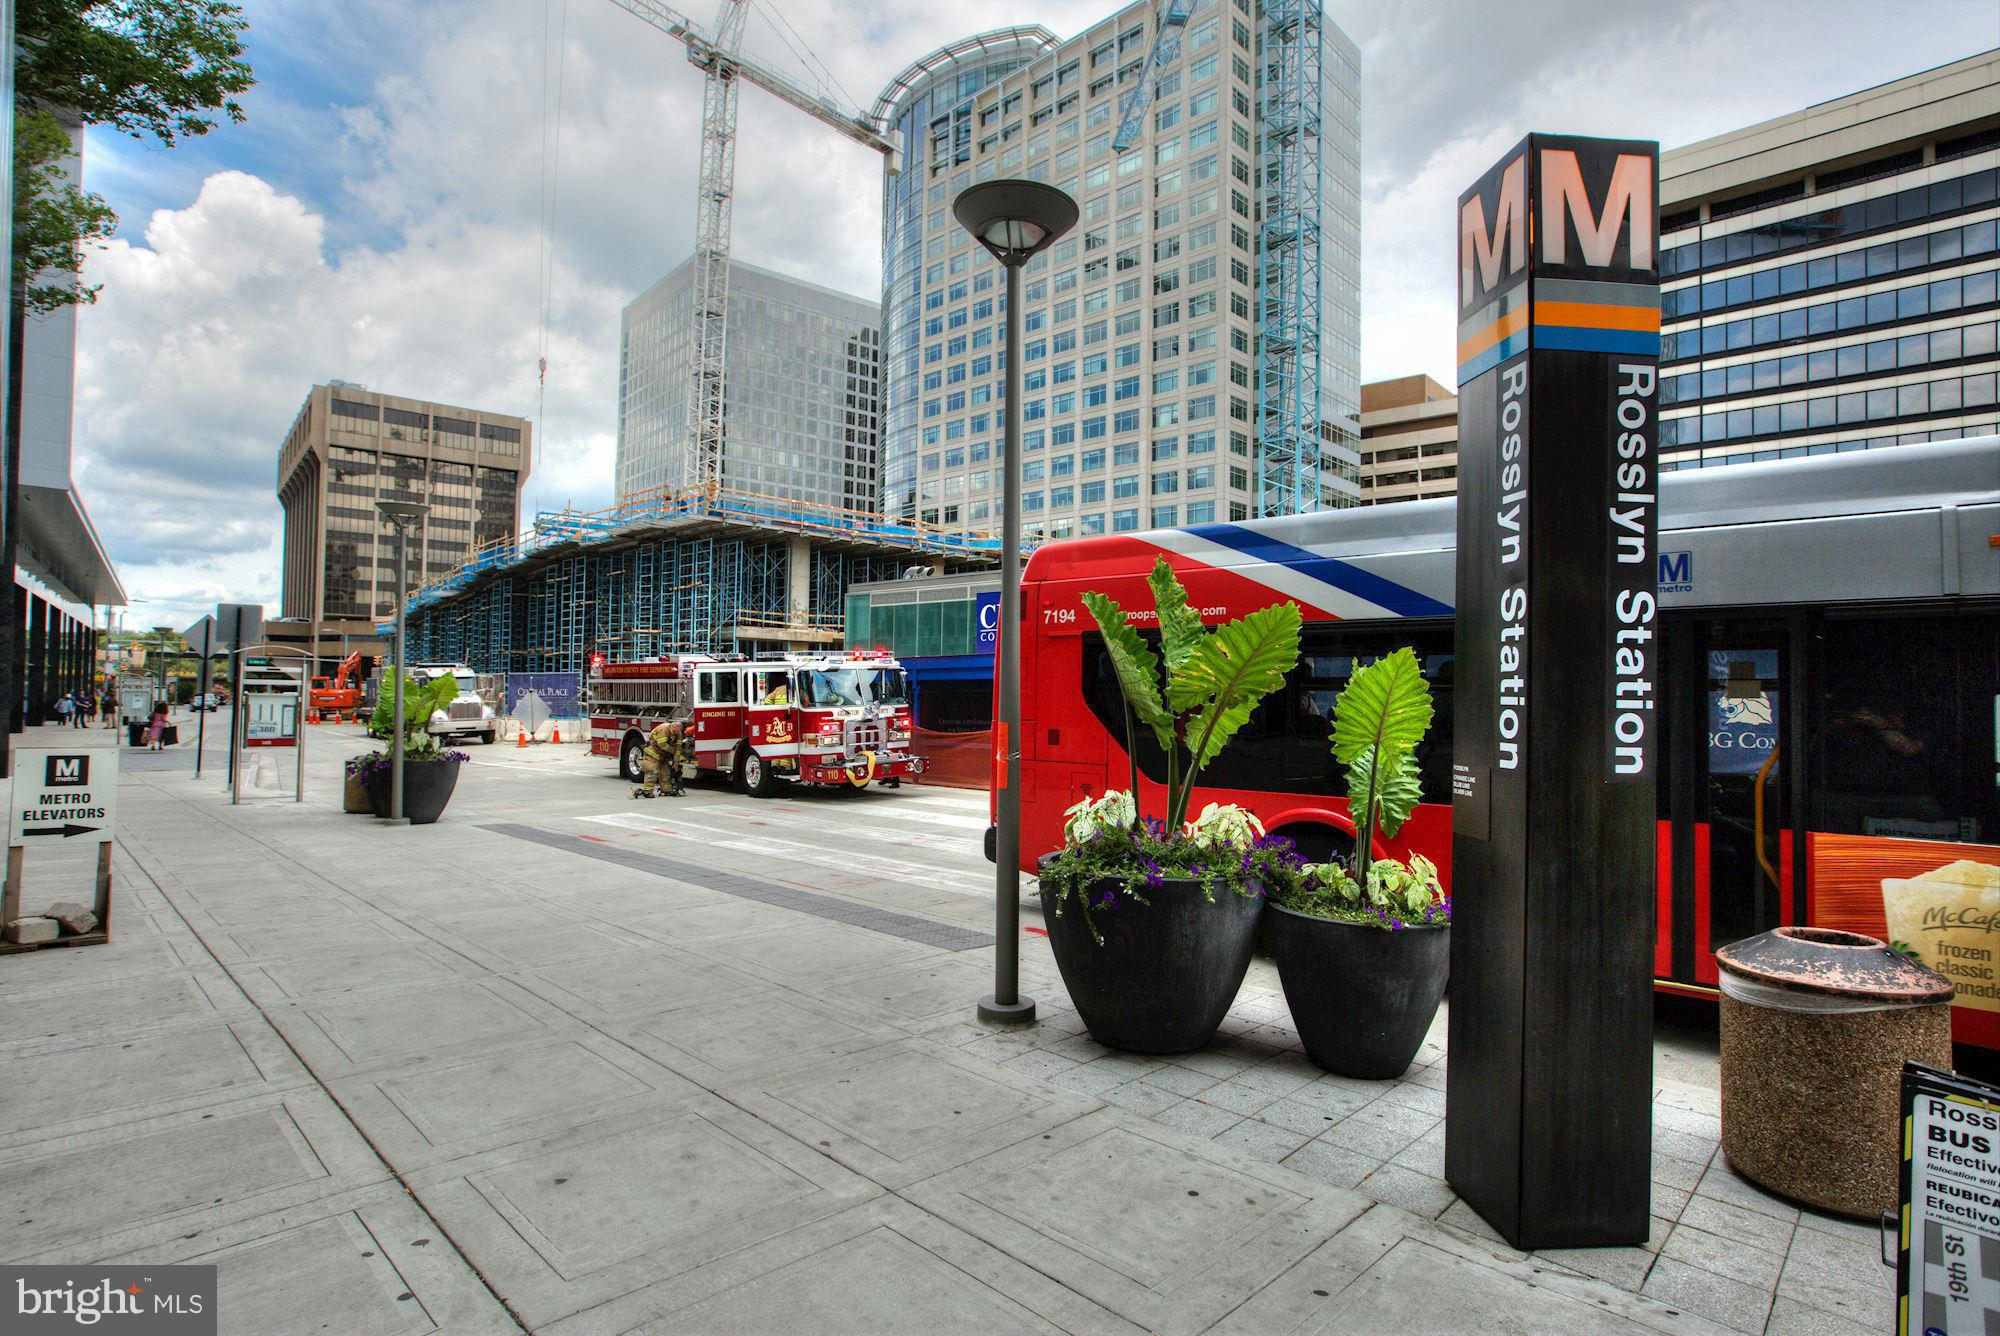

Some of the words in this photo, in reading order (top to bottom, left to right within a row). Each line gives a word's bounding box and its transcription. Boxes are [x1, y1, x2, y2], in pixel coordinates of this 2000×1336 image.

[1541, 148, 1653, 271] M
[1461, 152, 1525, 310] M
[1497, 361, 1527, 564] Rosslyn
[1609, 363, 1656, 564] Rosslyn
[1659, 553, 1689, 583] M
[980, 603, 1000, 629] C
[1044, 609, 1076, 624] 7194
[1499, 587, 1527, 770] Station
[1614, 589, 1656, 774] Station
[517, 687, 547, 697] CEAL
[547, 687, 569, 696] PLACE
[599, 741, 609, 752] 110
[55, 758, 80, 777] M
[827, 770, 839, 779] 110
[40, 793, 91, 805] METRO
[23, 807, 105, 821] ELEVATORS
[1937, 940, 1992, 962] frozen
[1936, 958, 1994, 980] classic
[1928, 1124, 1991, 1154] BUS
[1926, 1162, 1977, 1181] Relocation
[1980, 1177, 1996, 1187] will
[1926, 1195, 2000, 1226] Efectivo
[1944, 1234, 1965, 1257] St
[1947, 1262, 1970, 1303] 19th
